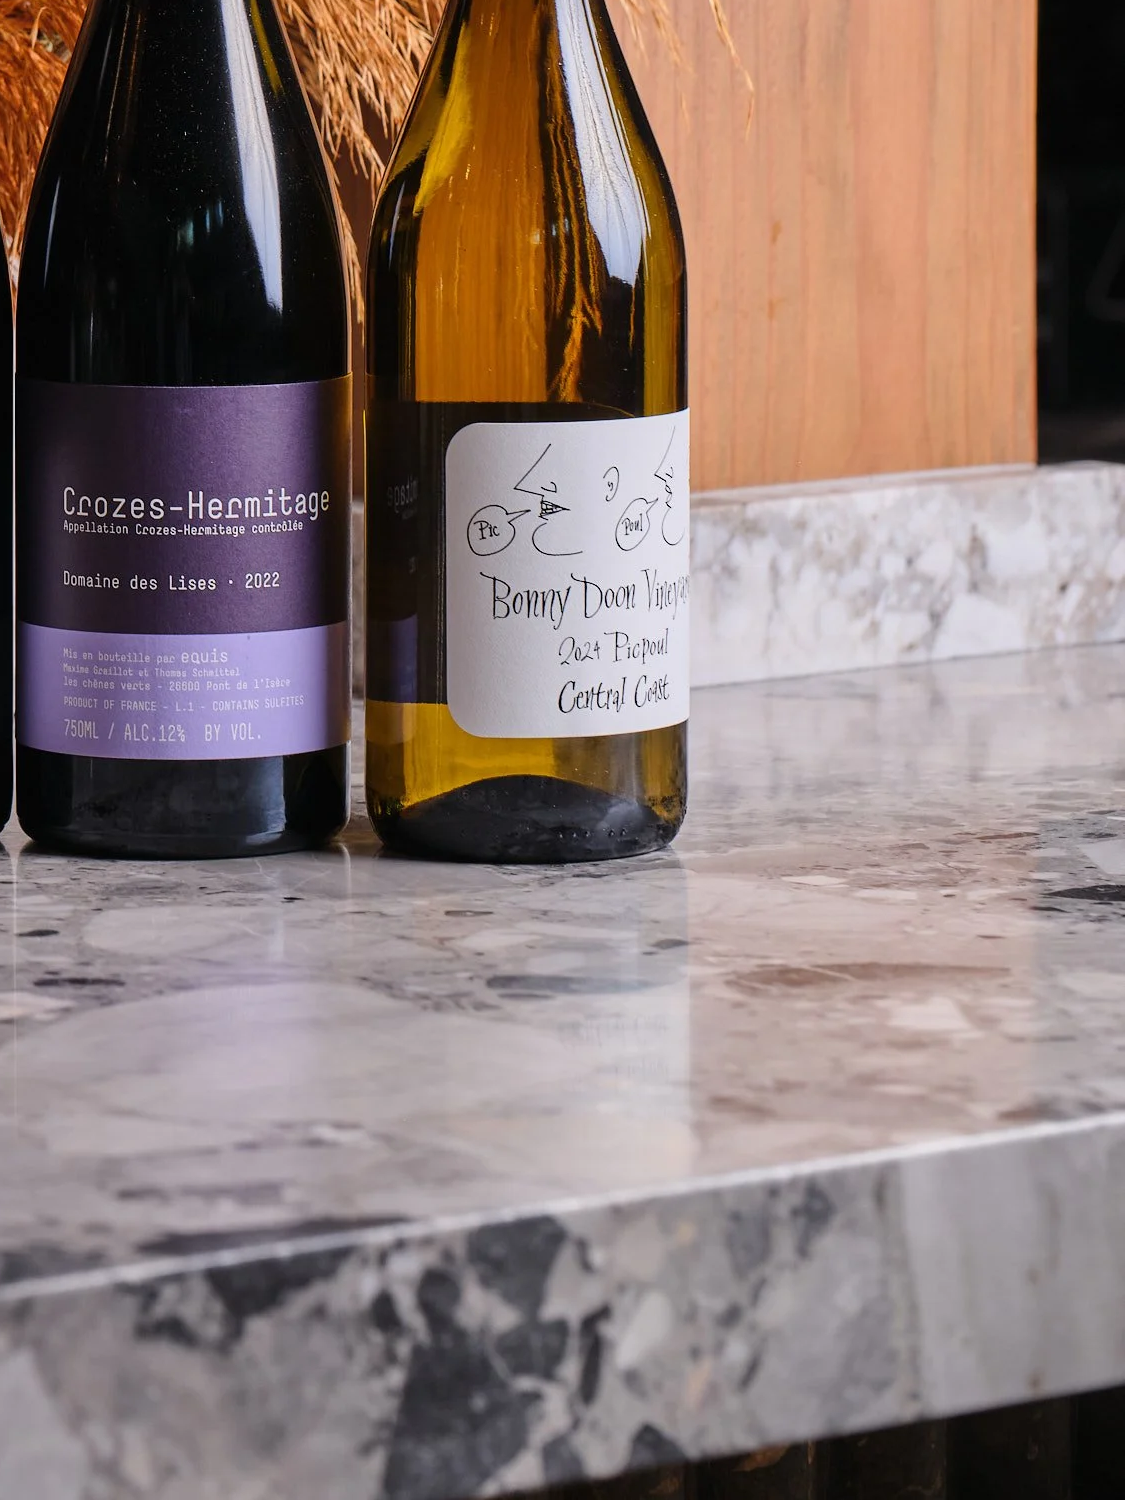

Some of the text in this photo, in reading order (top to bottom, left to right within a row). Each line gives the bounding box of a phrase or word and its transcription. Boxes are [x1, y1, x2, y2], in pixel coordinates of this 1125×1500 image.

[62, 486, 330, 521] Crozes-Hermitage
[63, 519, 304, 538] Appellation Crozes-Hermitage contrôlée
[474, 520, 500, 540] Pic
[63, 570, 120, 589] Domaine
[130, 574, 158, 590] des
[169, 574, 217, 591] Lises
[245, 571, 280, 589] 2022
[480, 571, 572, 631] Bonny
[570, 572, 636, 619] Doon
[558, 627, 669, 665] 2024 Picpoul
[63, 648, 229, 666] Mis en bouteille par equis
[62, 663, 90, 674] Maxime
[93, 665, 133, 677] Graillot
[138, 667, 149, 677] et
[154, 667, 187, 678] Thomas
[63, 676, 78, 688] les
[82, 679, 115, 690] chênes
[120, 682, 151, 691] verts
[206, 681, 231, 691] Pont
[236, 680, 248, 690] de
[558, 673, 670, 714] Central Coast
[63, 696, 98, 709] PRODUCT
[103, 699, 115, 710] OF
[120, 700, 157, 712] FRANCE
[175, 701, 195, 712] L.1
[212, 699, 259, 712] CONTAINS
[264, 695, 304, 709] SULFITES
[64, 718, 99, 740] 750ML
[124, 724, 186, 743] ALC.12%
[204, 724, 221, 742] BY
[230, 722, 263, 741] VOL.
